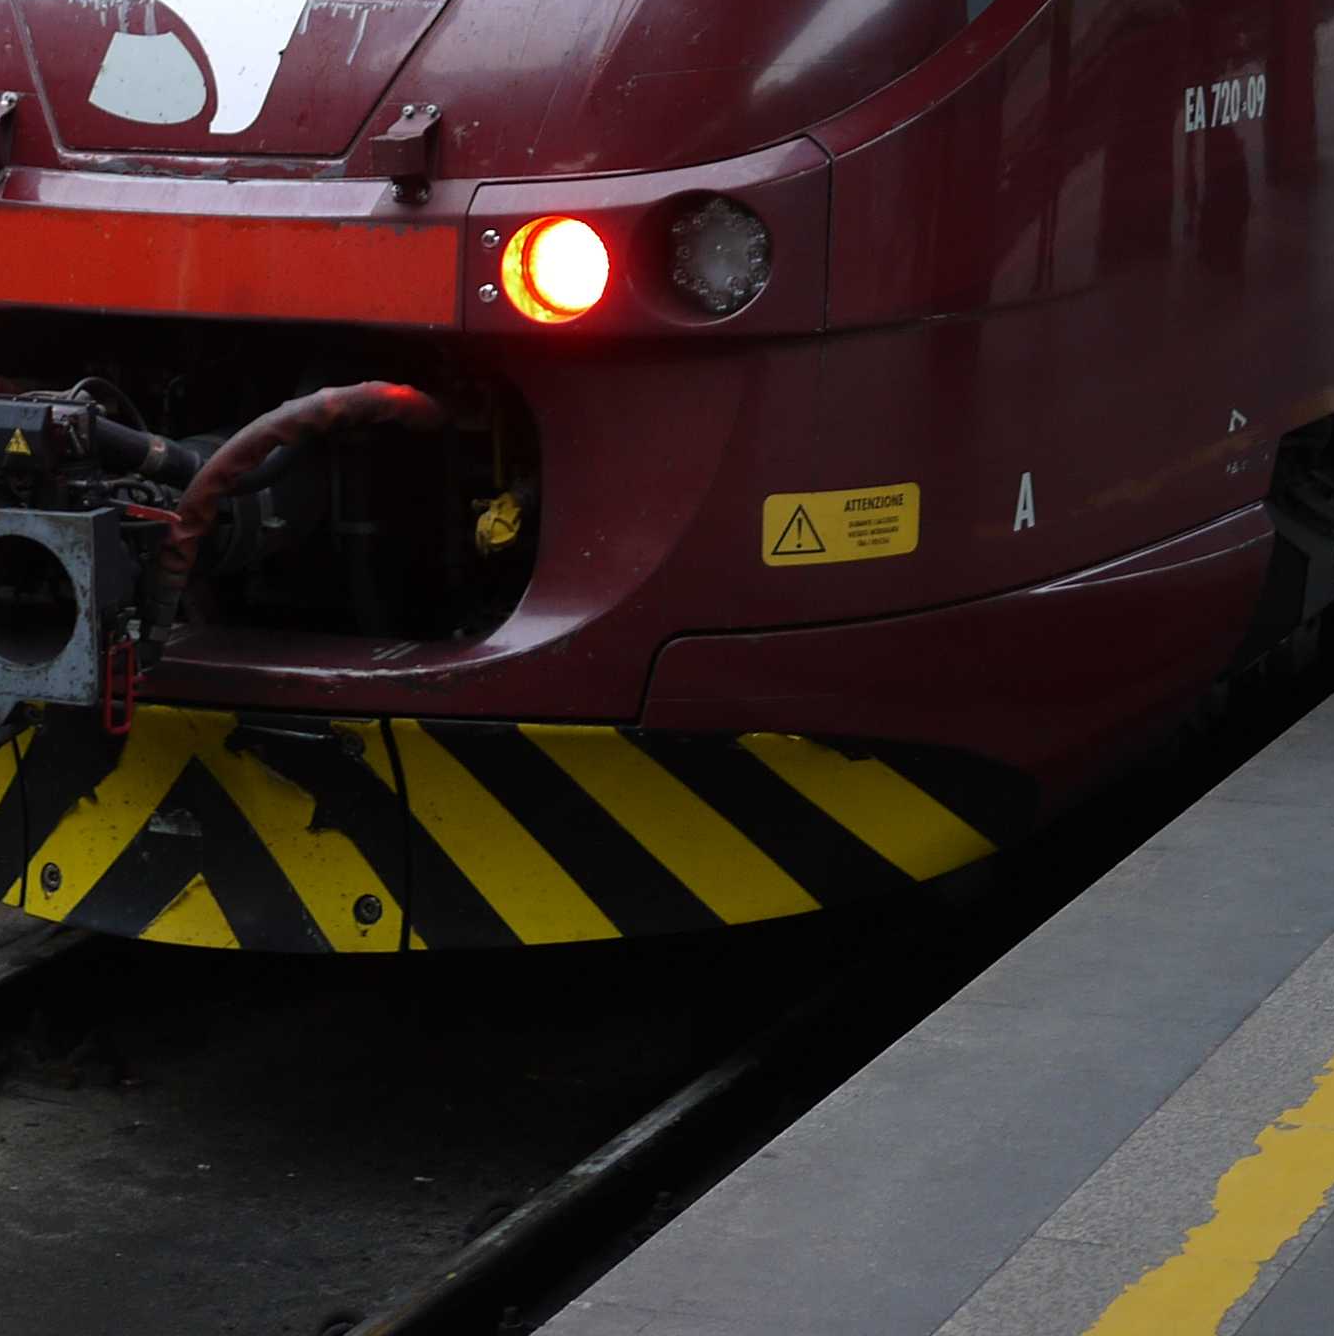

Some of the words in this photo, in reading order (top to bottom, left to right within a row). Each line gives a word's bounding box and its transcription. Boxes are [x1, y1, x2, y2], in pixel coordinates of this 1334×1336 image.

[1185, 86, 1206, 133] EA
[1211, 74, 1265, 128] 720-09
[843, 493, 904, 513] ATTENZIONE
[1013, 470, 1036, 533] A
